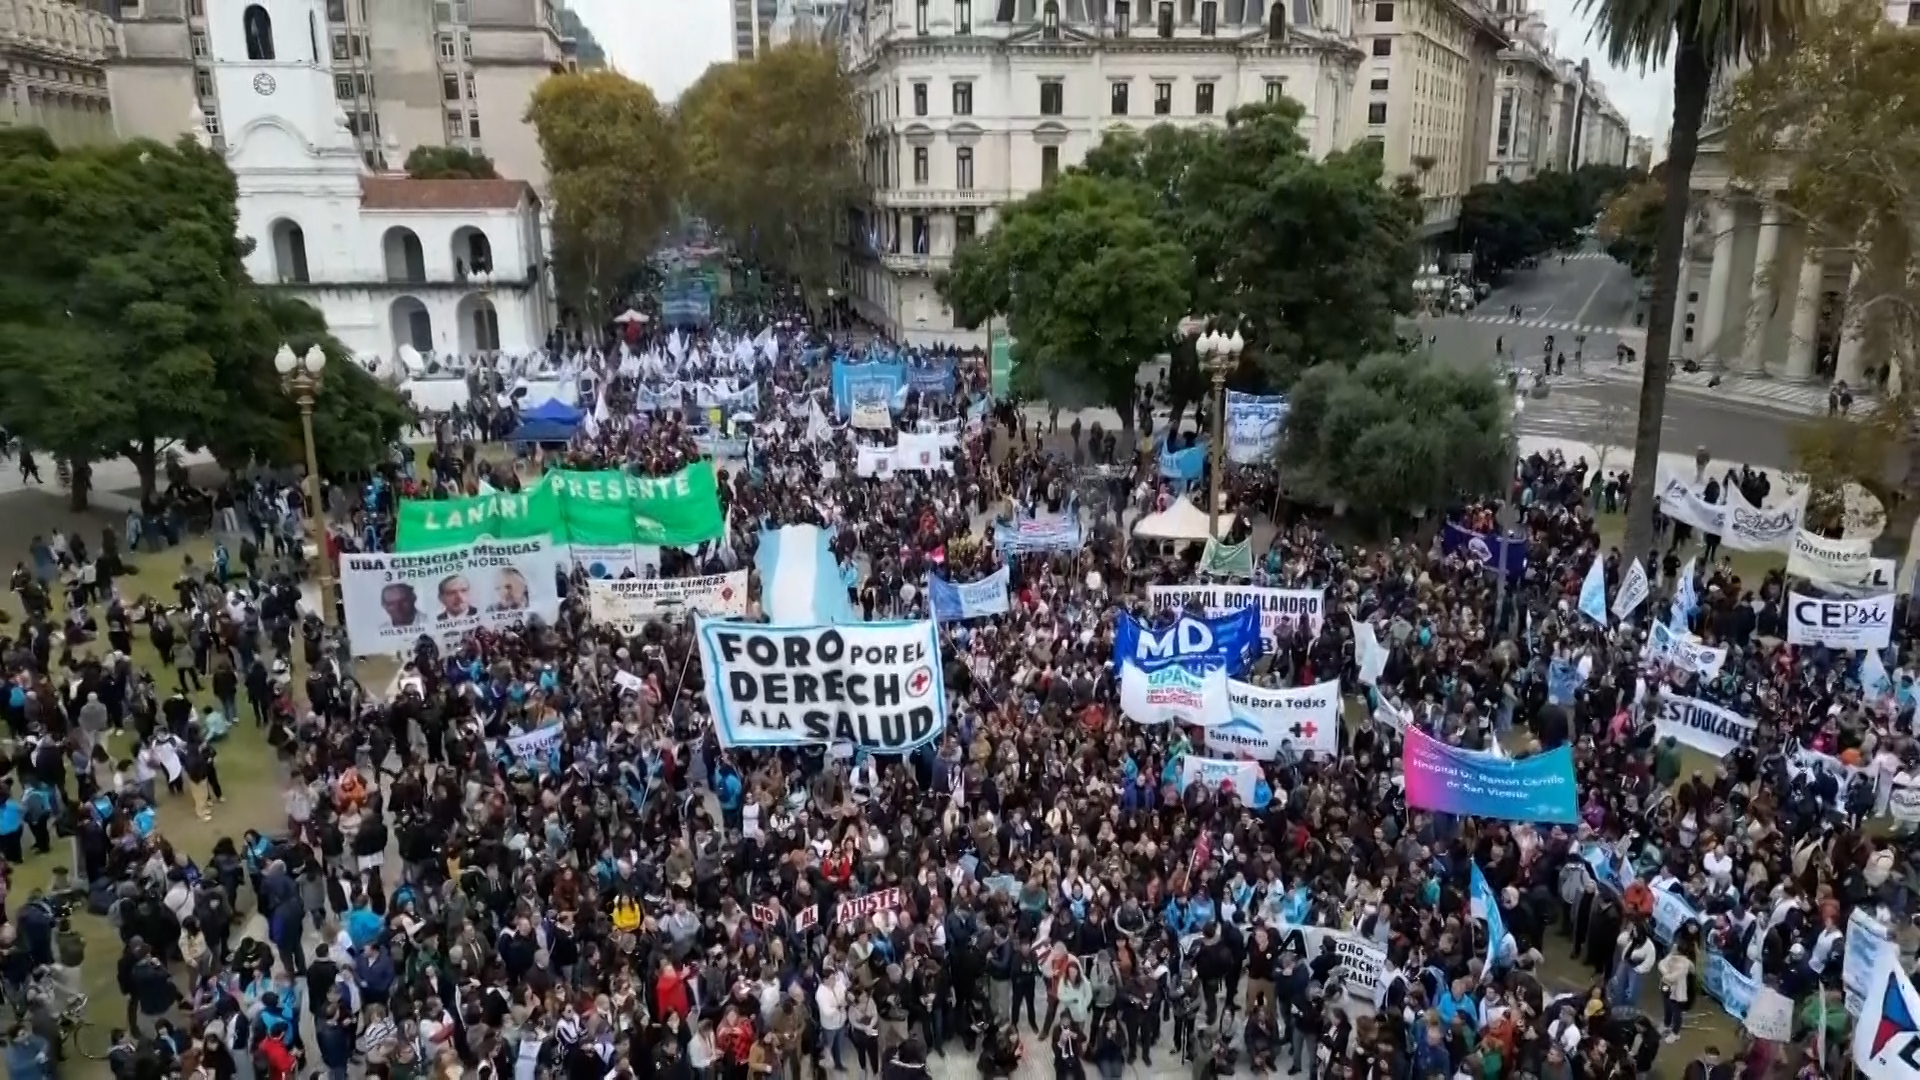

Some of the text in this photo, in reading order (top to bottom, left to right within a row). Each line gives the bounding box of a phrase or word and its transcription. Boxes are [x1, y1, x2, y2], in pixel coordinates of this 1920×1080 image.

[424, 475, 691, 530] LANARI PRESENTE
[350, 559, 386, 572] UBA
[390, 549, 469, 570] CIENCIAS
[384, 557, 514, 582] 3 PREMIOS NOBEL
[611, 582, 659, 593] HOSPITAL
[1153, 591, 1318, 614] HOSPTAL BOCALANDRO
[1795, 601, 1887, 628] CEPsi
[717, 629, 925, 668] FORO POR EL
[1136, 617, 1213, 660] MD
[729, 665, 933, 707] DERECHO
[1251, 698, 1283, 708] para
[1285, 697, 1327, 708] Todxs
[739, 705, 934, 748] A LA SALUD
[1209, 730, 1229, 742] San
[1413, 759, 1458, 776] Hospital
[1447, 781, 1460, 790] de
[1463, 784, 1484, 794] San
[754, 906, 774, 922] NO
[802, 906, 817, 925] AL
[839, 888, 900, 920] AJUSTE
[1338, 943, 1364, 956] ORO
